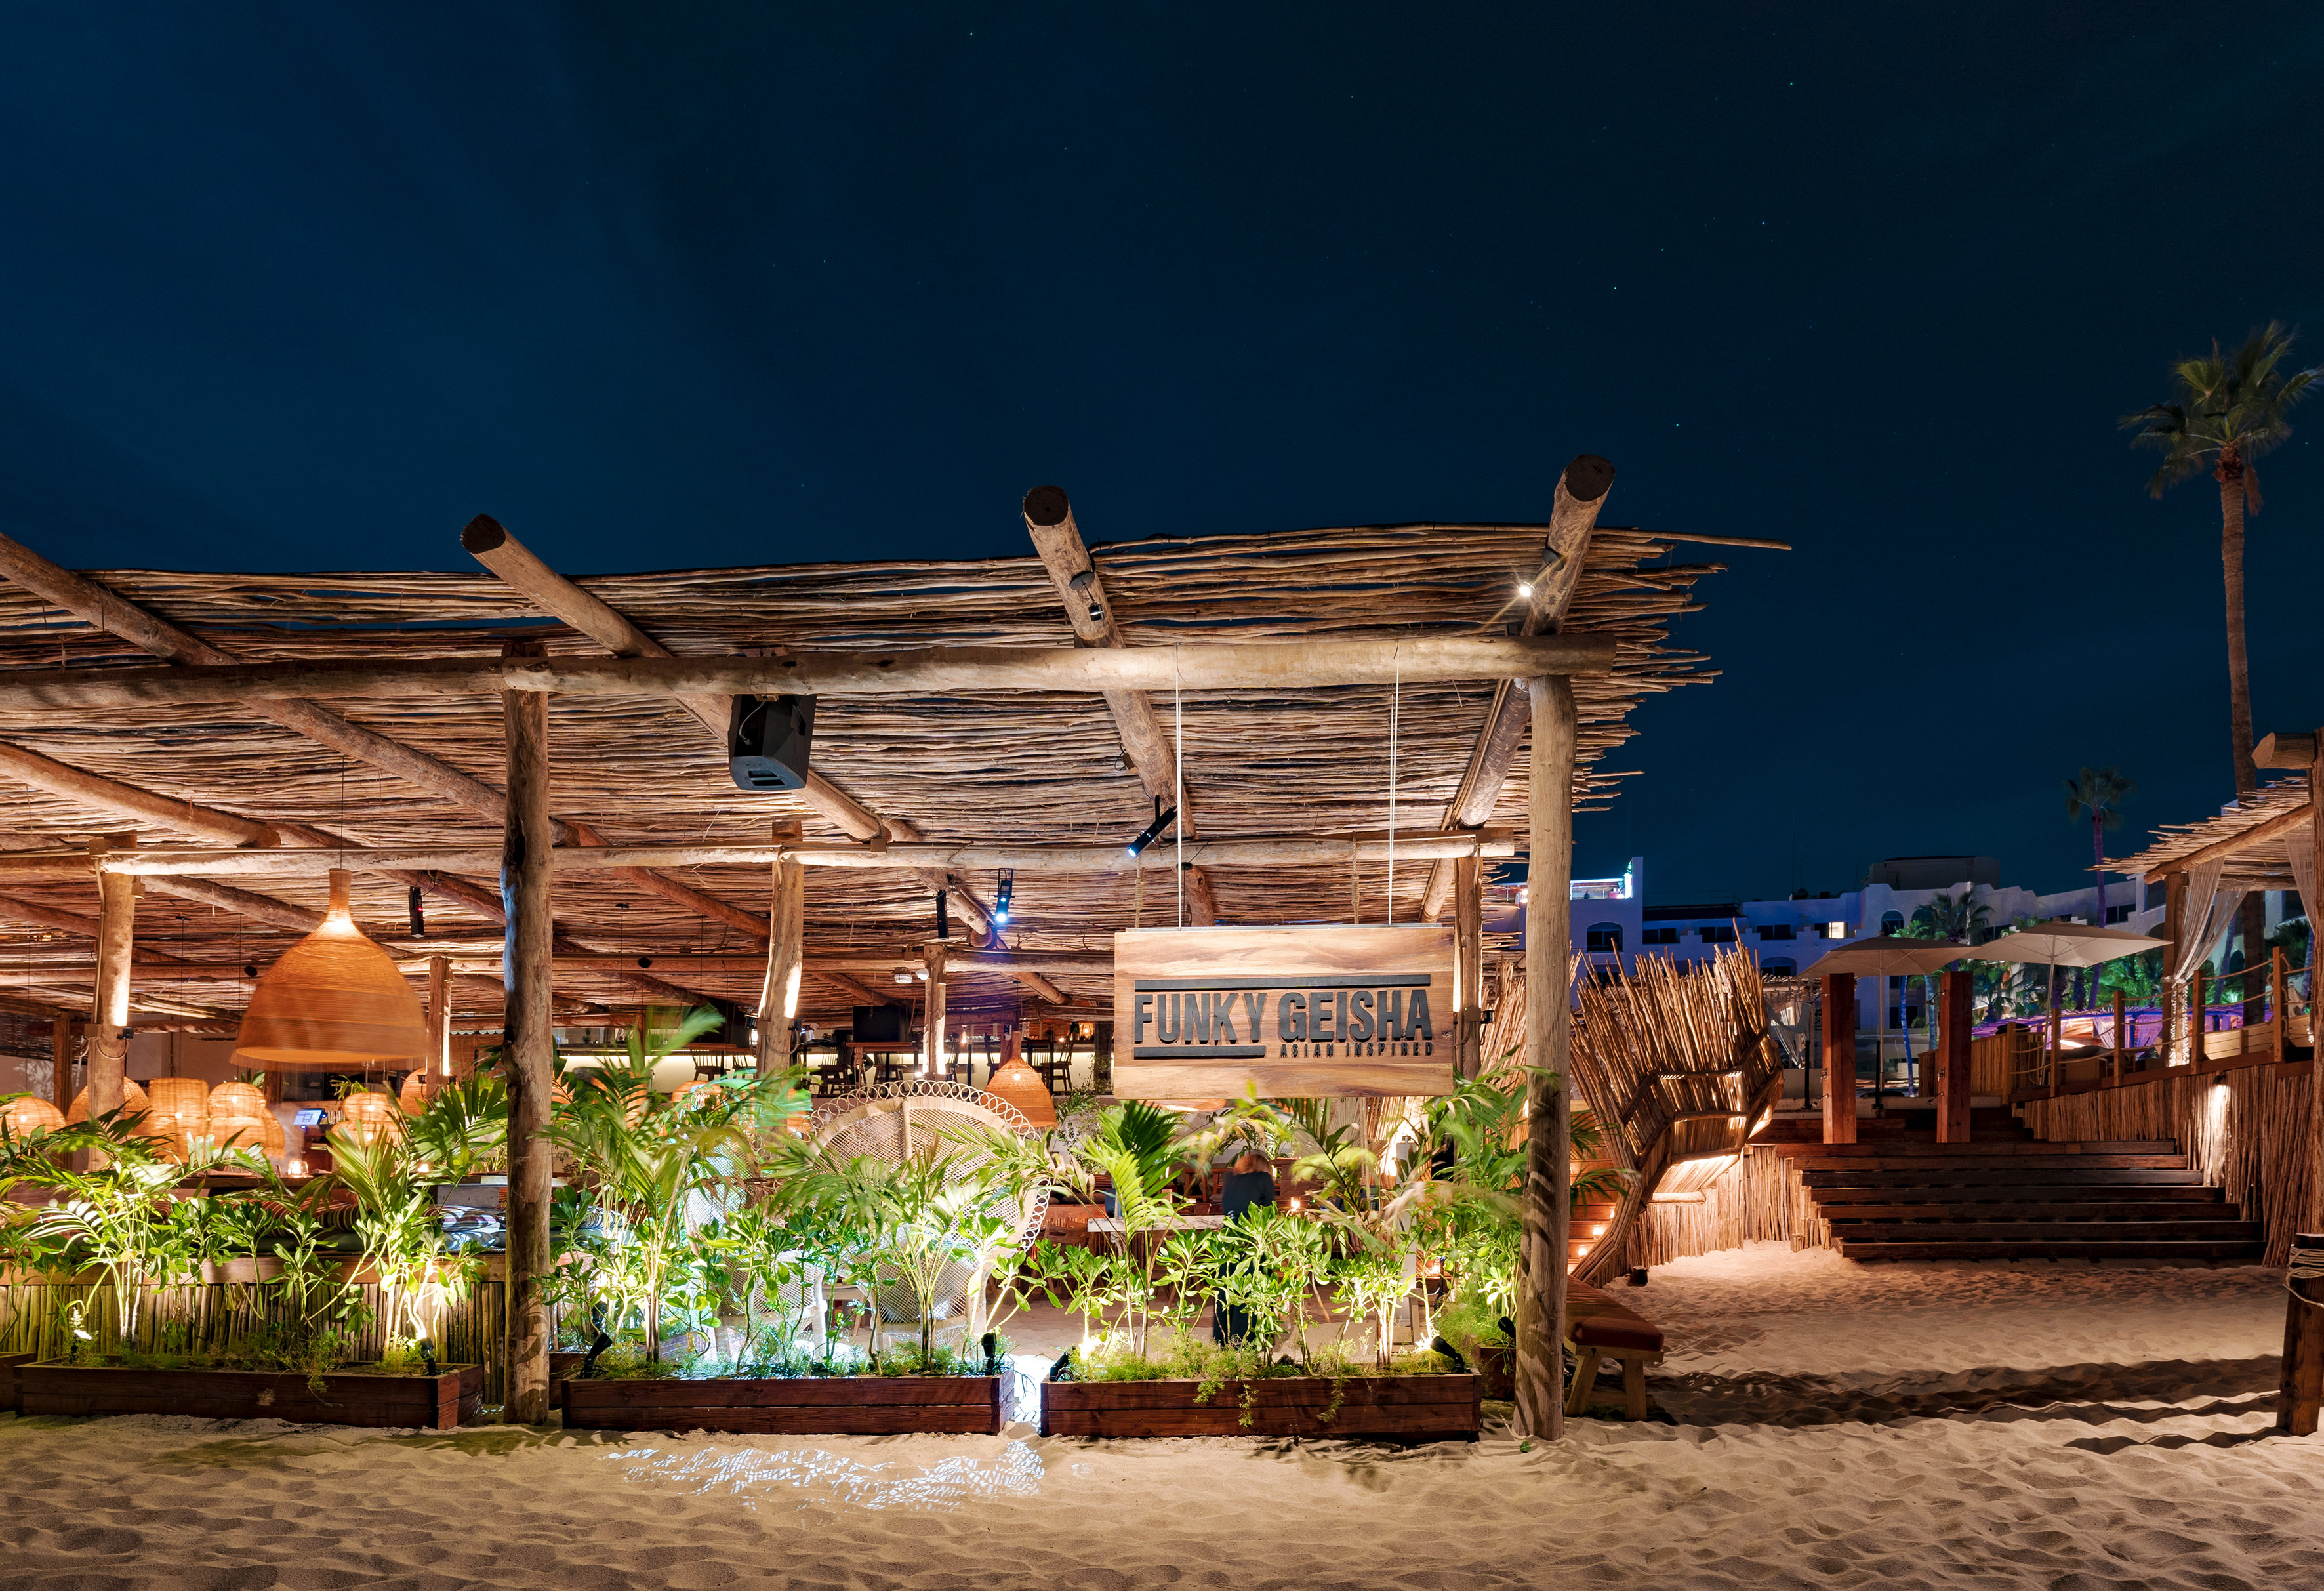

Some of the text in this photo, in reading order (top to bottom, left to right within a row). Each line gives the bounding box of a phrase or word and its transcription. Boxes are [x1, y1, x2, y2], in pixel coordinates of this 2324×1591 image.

[1134, 989, 1433, 1044] FUNKY GEISHA
[1280, 1042, 1433, 1058] ASIAN INSPIRED
